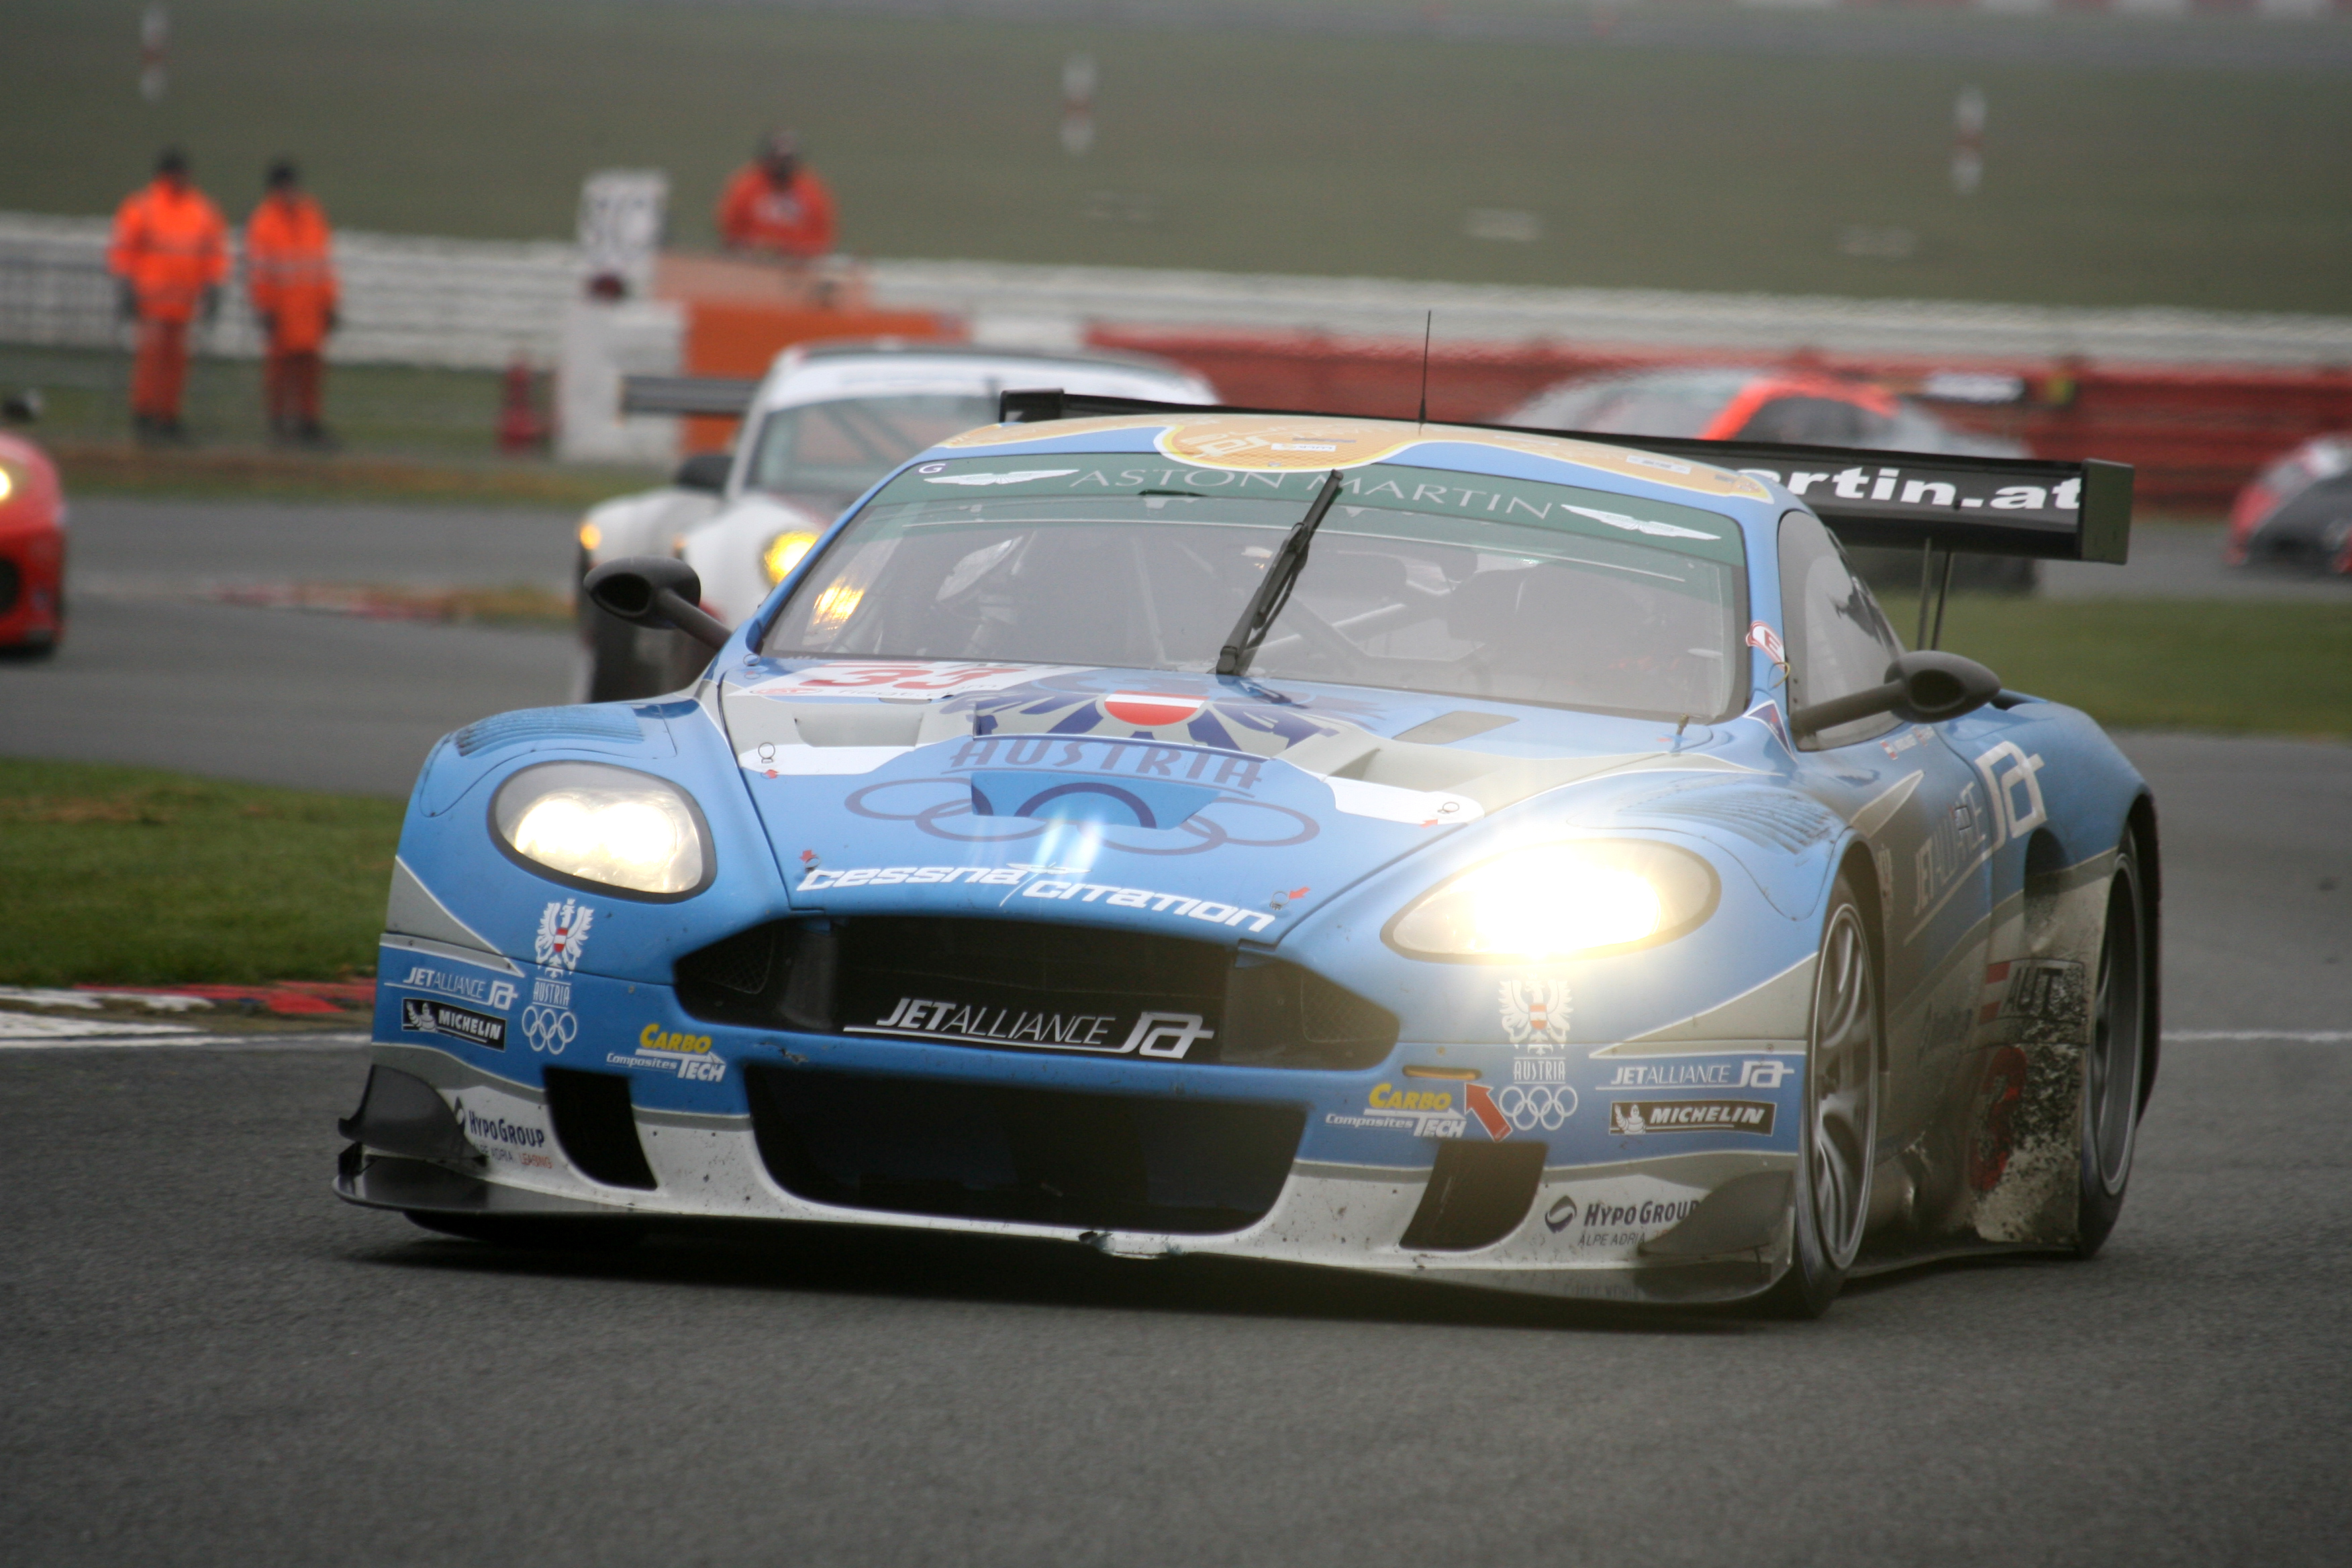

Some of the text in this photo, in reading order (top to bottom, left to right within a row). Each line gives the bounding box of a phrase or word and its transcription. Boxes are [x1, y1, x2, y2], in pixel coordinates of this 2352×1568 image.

[919, 463, 946, 474] G
[1069, 469, 1553, 520] ASTON MARTIN
[949, 739, 1263, 790] AUSTRIA
[403, 967, 487, 999] JETALLIANCE
[532, 981, 571, 1007] AUSTRIA
[438, 1009, 502, 1040] MICHELIN
[875, 997, 1116, 1046] JETALLIANCE
[640, 1022, 712, 1054] CARBO
[606, 1052, 726, 1083] Composites TECH
[1513, 1060, 1565, 1081] AUSTRIA
[1610, 1065, 1731, 1086] JETALLIANCE
[1368, 1082, 1452, 1111] CARBO
[1325, 1112, 1467, 1138] Composites TECH
[1649, 1106, 1765, 1125] MICHELIN
[1577, 1233, 1610, 1246] ALPE
[1610, 1232, 1647, 1246] ADRIA
